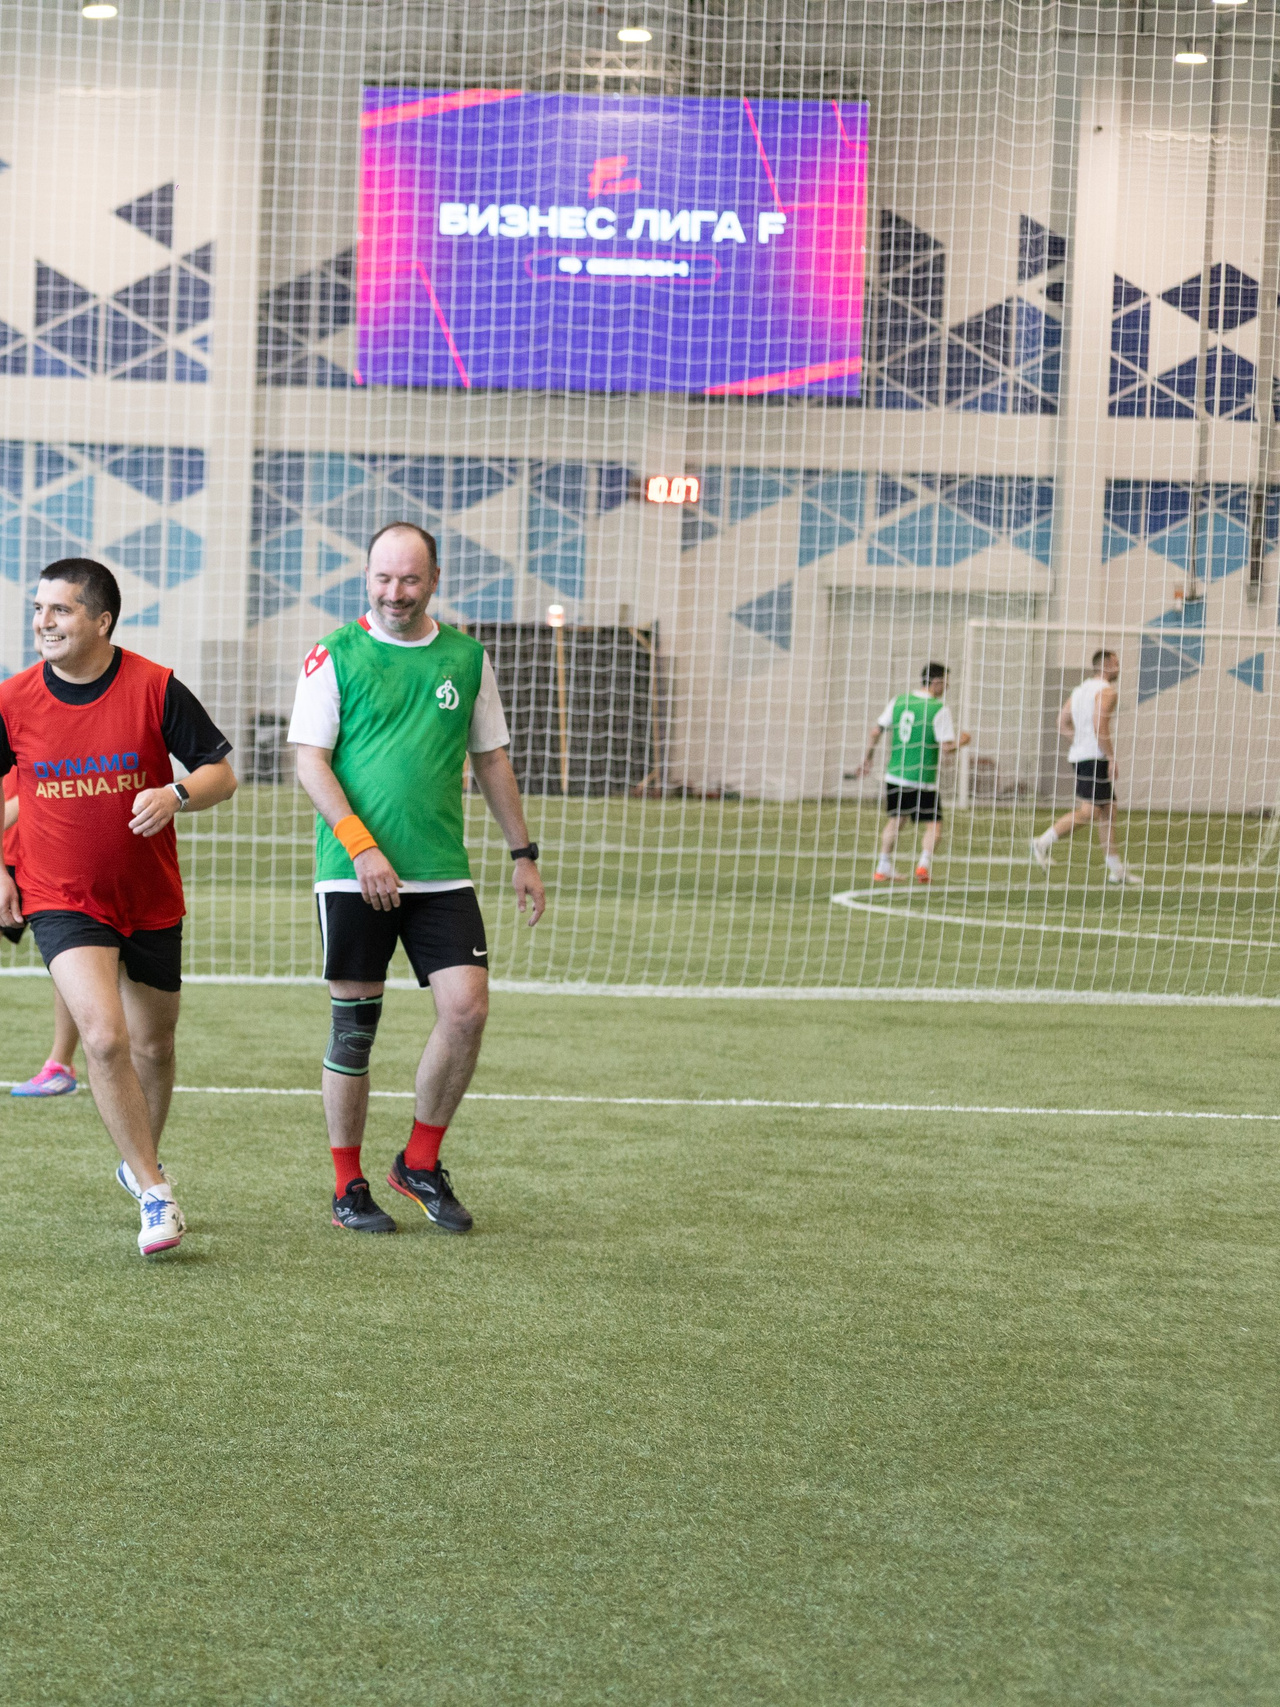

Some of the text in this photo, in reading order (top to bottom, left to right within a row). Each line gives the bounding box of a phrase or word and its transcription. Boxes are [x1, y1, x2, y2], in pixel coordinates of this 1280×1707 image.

[439, 202, 787, 244] БИЗНЕС ЛИГА F
[33, 752, 139, 778] DYNAMO
[35, 771, 147, 799] ARENA.RU
